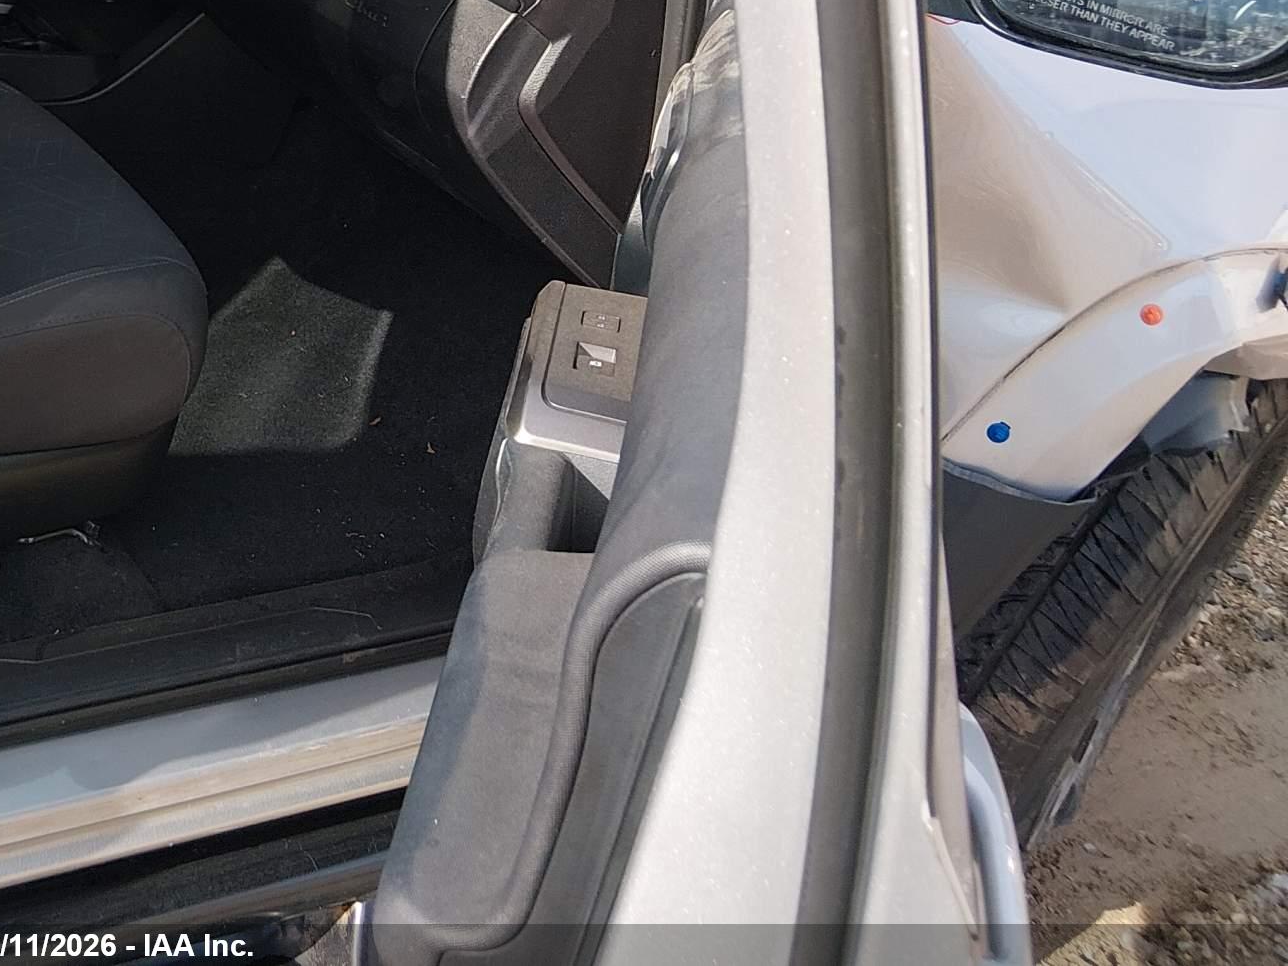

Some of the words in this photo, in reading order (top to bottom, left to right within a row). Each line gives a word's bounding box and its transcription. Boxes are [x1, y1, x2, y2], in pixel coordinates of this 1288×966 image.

[1070, 4, 1099, 23] THAN
[1100, 16, 1129, 34] THEY
[1128, 27, 1176, 51] APPEAR
[1086, 0, 1100, 11] IN
[1099, 4, 1145, 28] MIRROR
[1144, 21, 1169, 37] ARE
